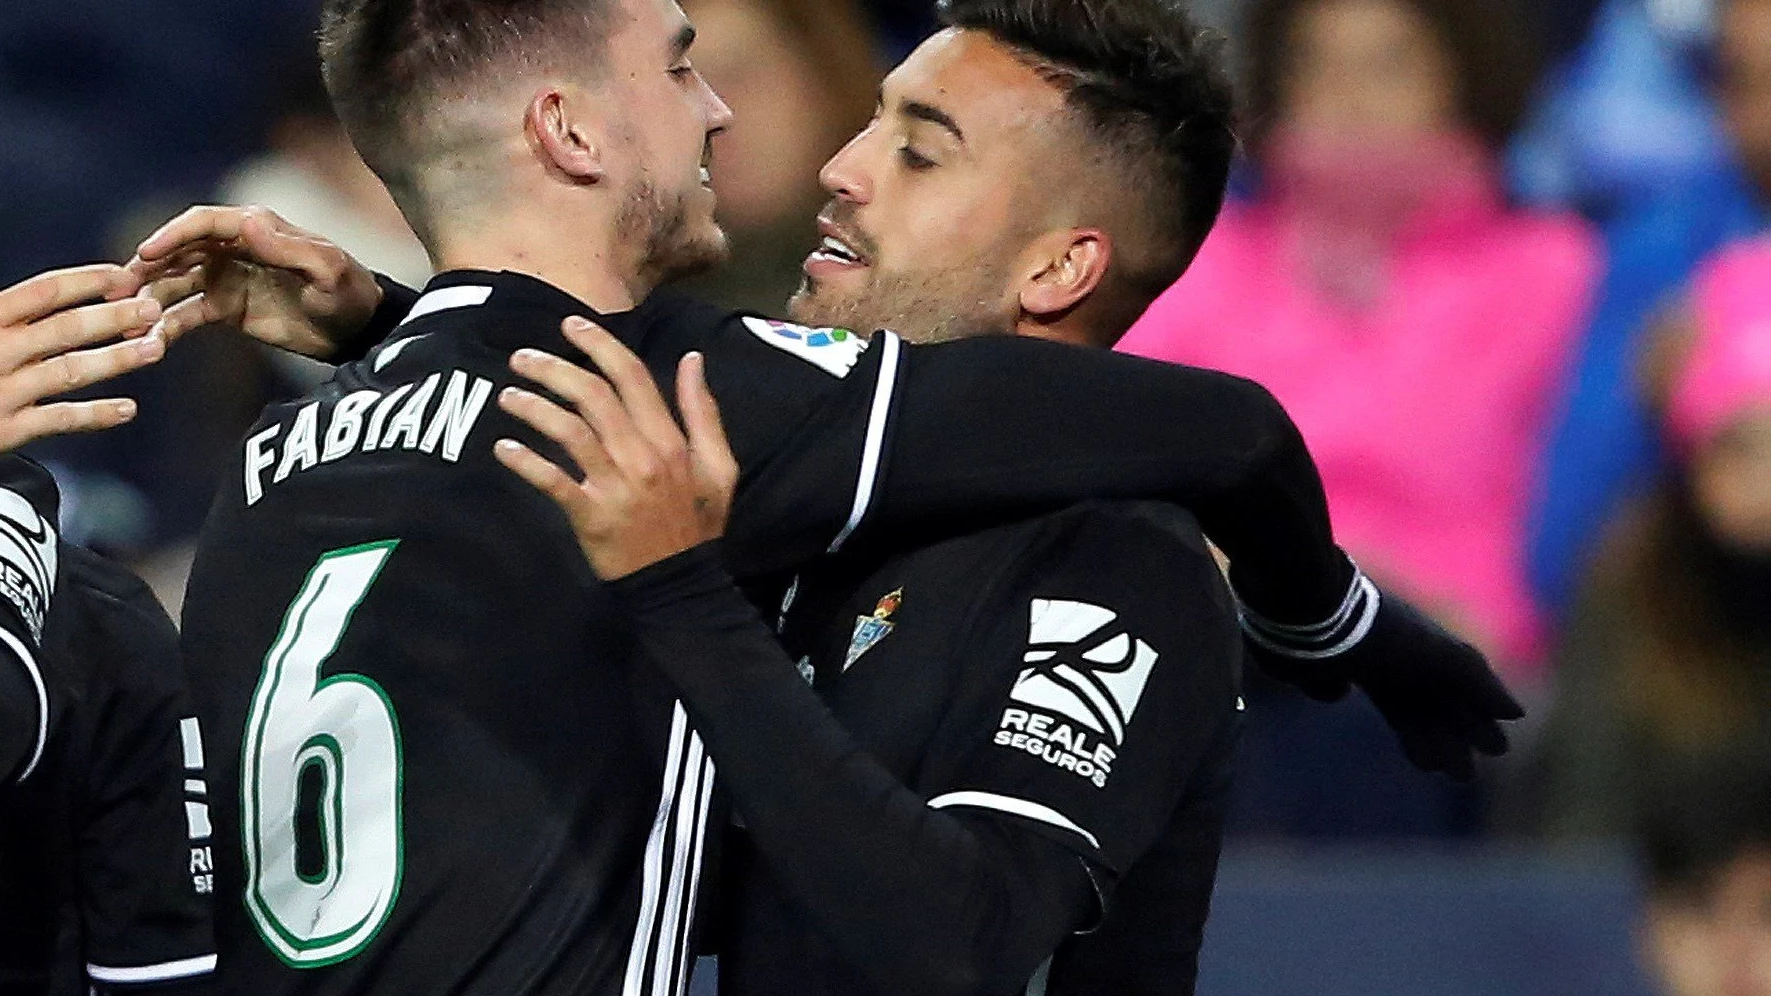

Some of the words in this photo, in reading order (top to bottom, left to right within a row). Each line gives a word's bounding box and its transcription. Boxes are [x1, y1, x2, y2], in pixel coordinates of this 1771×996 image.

[244, 369, 493, 506] FABIAN
[239, 538, 402, 969] 6
[993, 730, 1108, 788] SEGUROS
[1000, 707, 1117, 774] REALE
